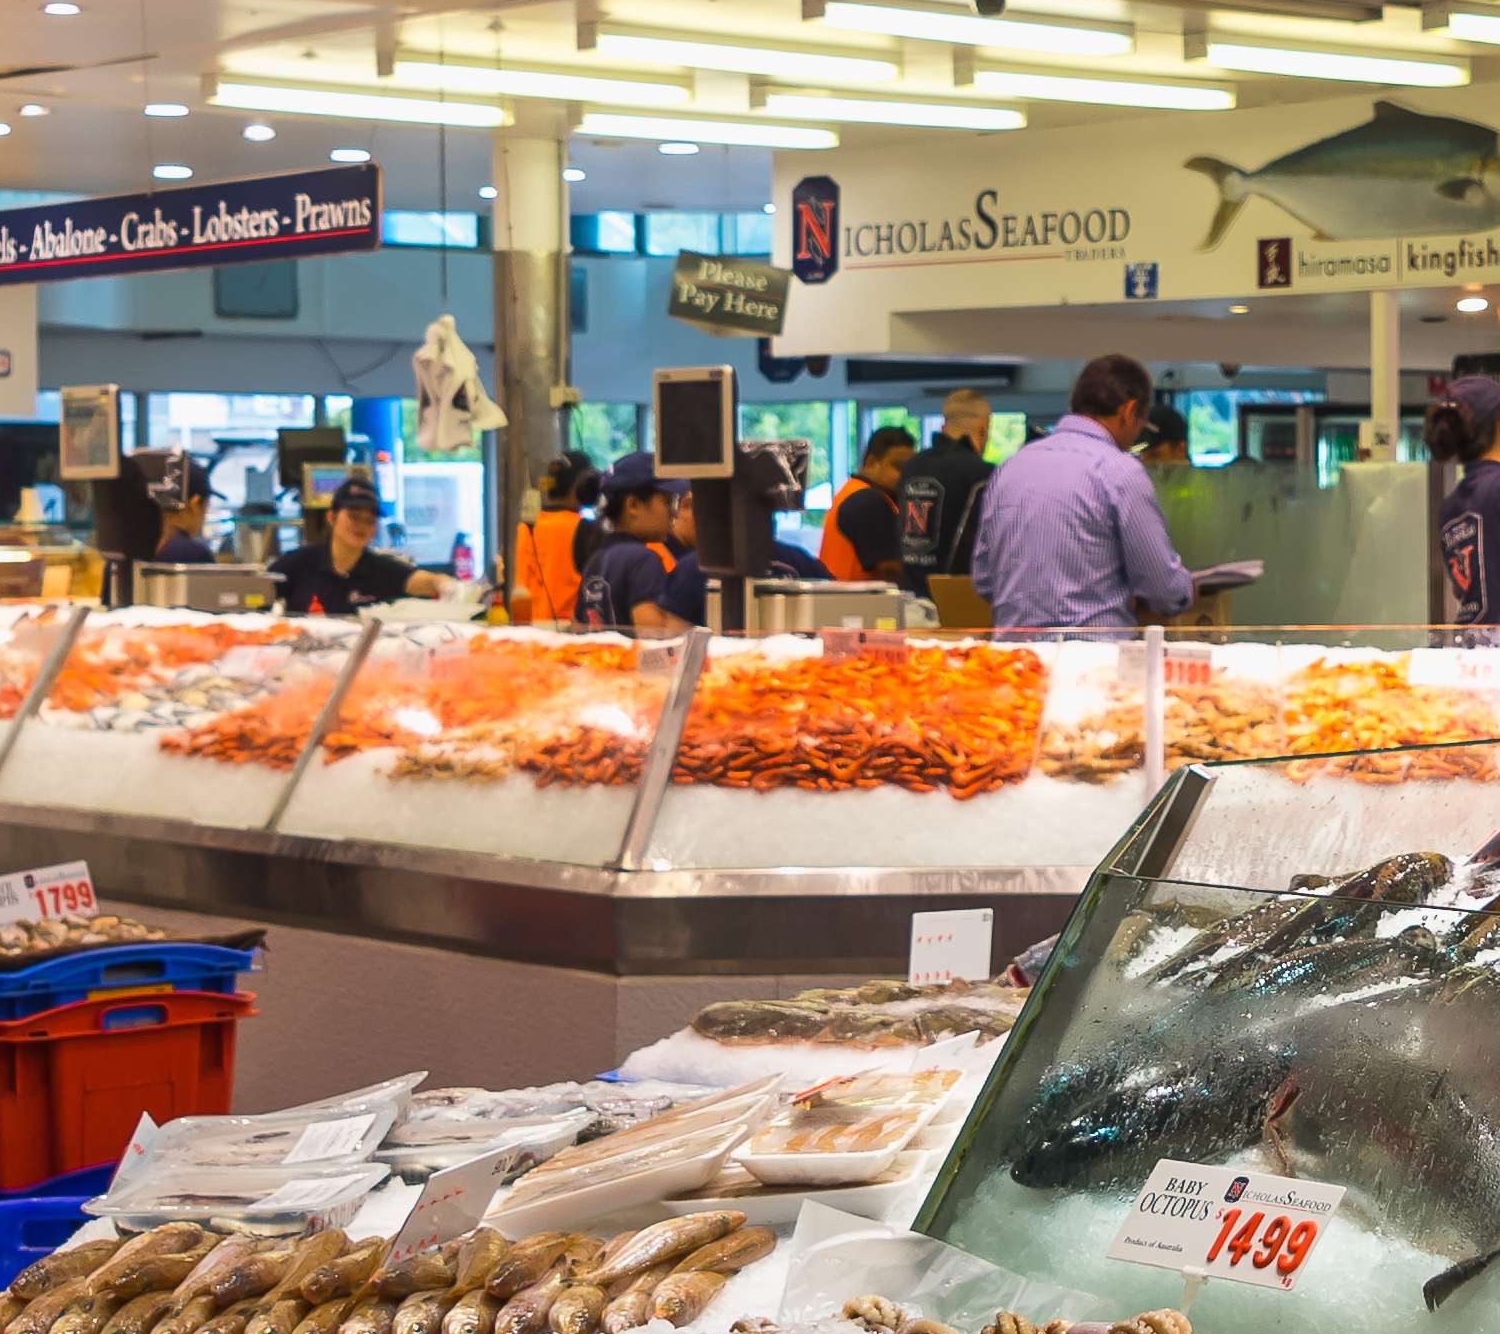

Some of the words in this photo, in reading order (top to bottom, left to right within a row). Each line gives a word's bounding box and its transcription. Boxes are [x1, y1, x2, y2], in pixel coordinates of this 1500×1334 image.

[29, 217, 106, 260] Abalone
[121, 207, 177, 250] Crabs
[192, 201, 278, 243] Lobsters
[294, 193, 371, 233] Prawns
[699, 259, 767, 291] Please
[1407, 238, 1500, 277] kingfish
[679, 282, 720, 314] Pay
[724, 291, 778, 320] Here
[1165, 1177, 1208, 1196] BABY
[1140, 1192, 1213, 1220] OCTOPUS
